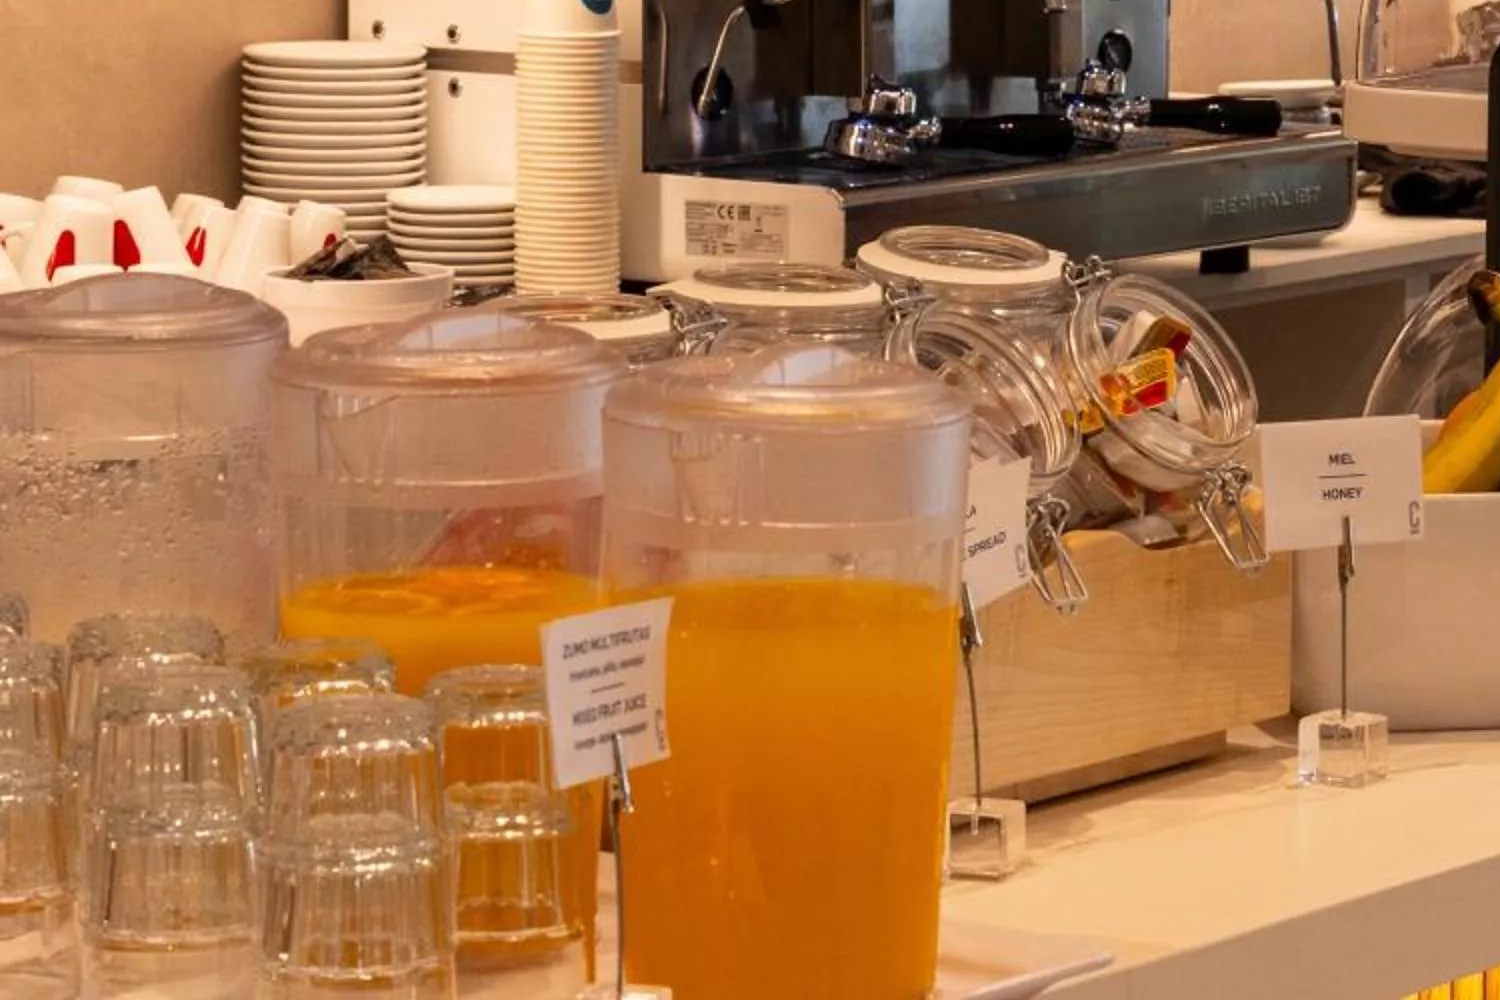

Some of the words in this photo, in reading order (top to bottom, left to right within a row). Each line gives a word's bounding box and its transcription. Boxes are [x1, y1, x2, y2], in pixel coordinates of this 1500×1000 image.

[1328, 453, 1356, 466] MIEL
[1322, 487, 1364, 501] HONEY
[967, 530, 1007, 558] SPREAD
